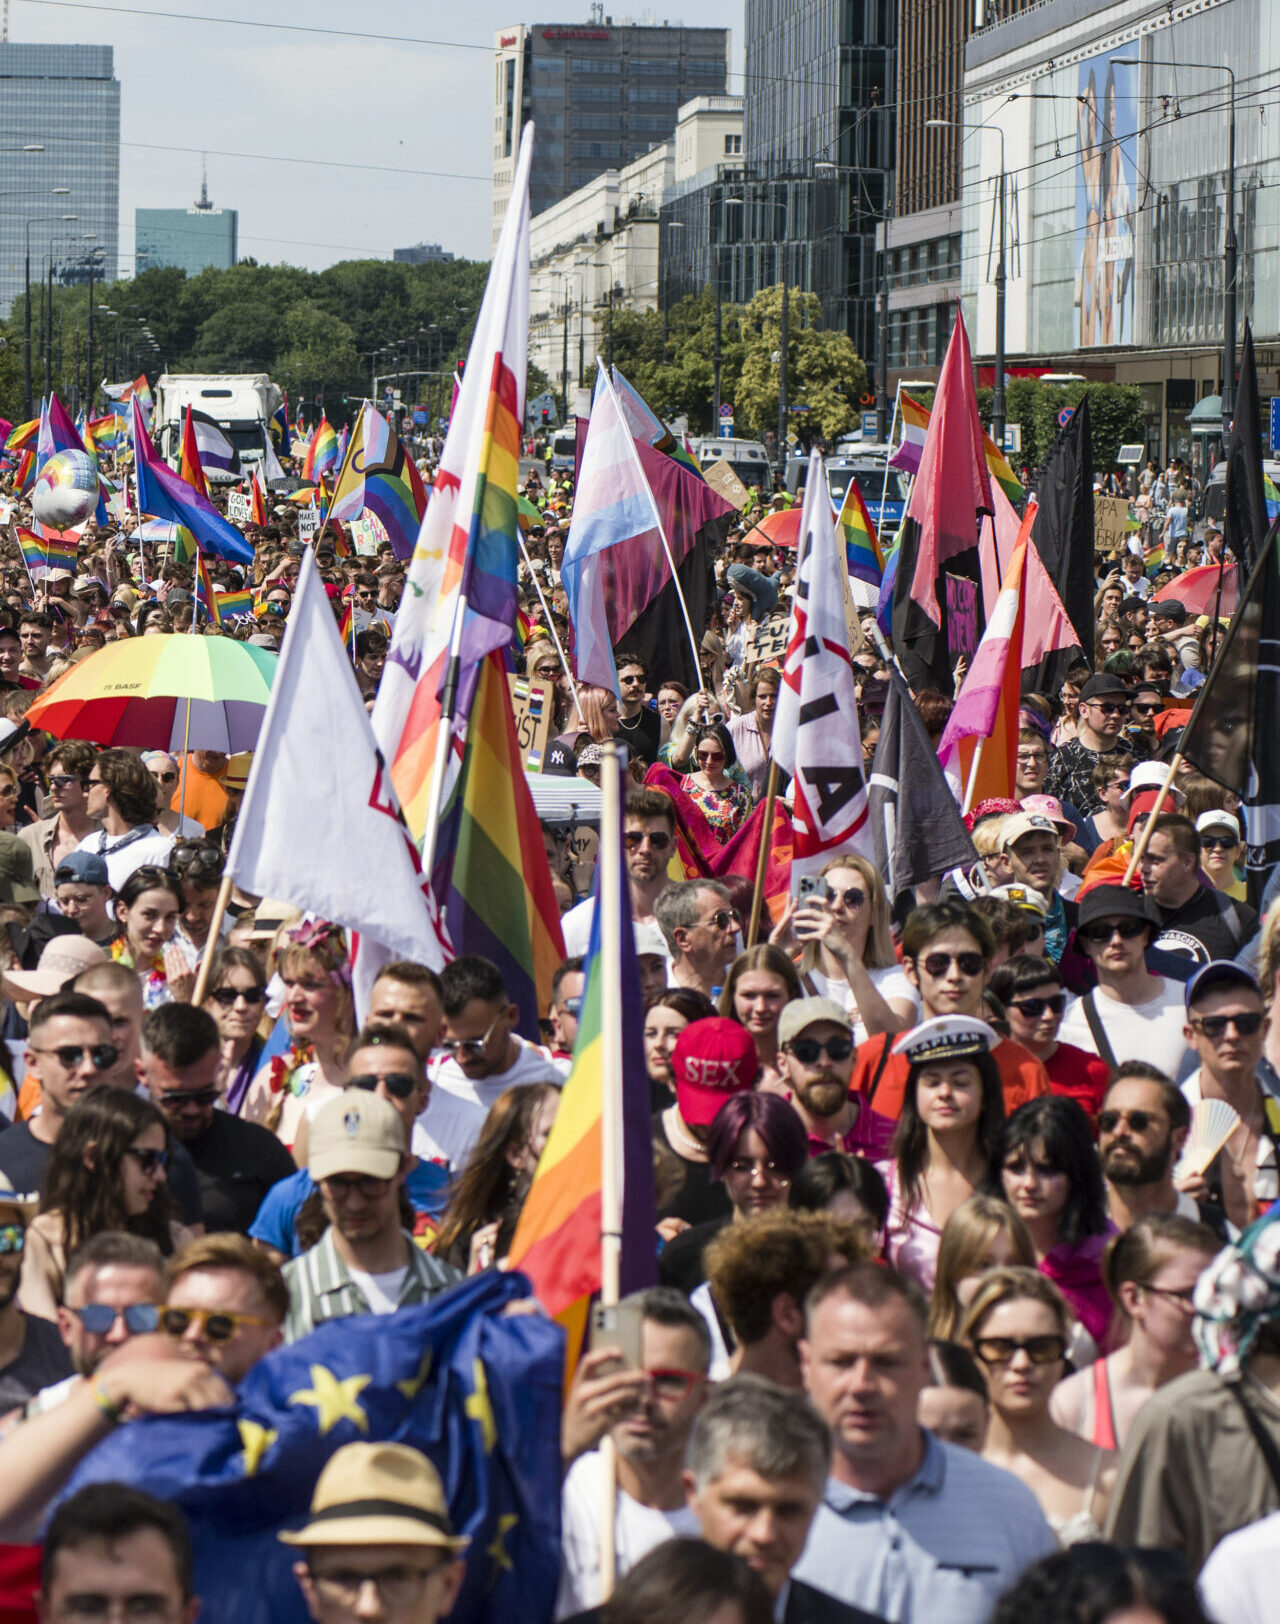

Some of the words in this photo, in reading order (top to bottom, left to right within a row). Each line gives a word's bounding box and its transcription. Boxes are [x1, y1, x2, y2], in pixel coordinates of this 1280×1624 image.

[300, 522, 317, 532] NOT
[755, 621, 791, 643] FU
[753, 636, 788, 658] TE
[549, 749, 566, 765] NY
[909, 1033, 981, 1054] KAPITAN
[685, 1055, 742, 1087] SEX
